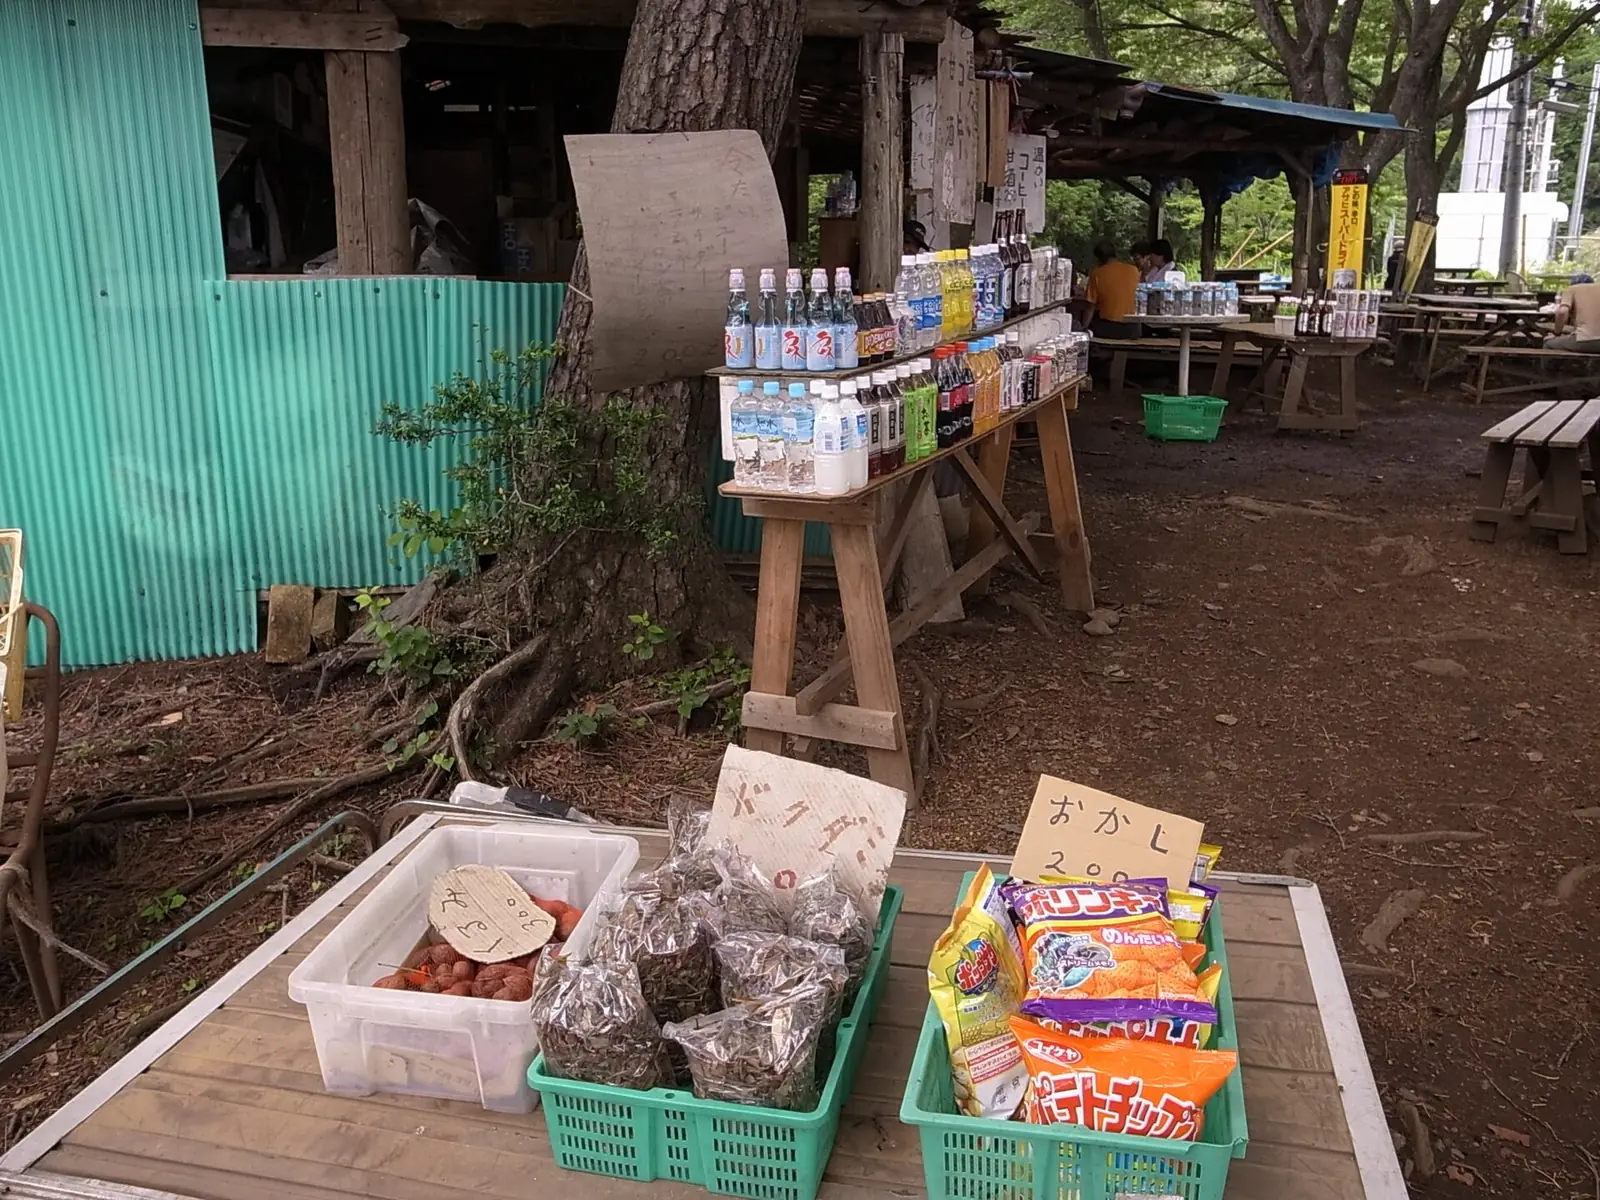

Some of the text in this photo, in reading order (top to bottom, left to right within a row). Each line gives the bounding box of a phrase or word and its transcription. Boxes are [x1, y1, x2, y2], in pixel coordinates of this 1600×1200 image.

[1337, 186, 1351, 268] アサヒスーパードライ
[1049, 794, 1169, 855] おかし
[1044, 850, 1129, 883] 200
[441, 887, 503, 954] くるみ
[506, 897, 549, 932] 300
[1021, 887, 1164, 920] ポリンキー
[1032, 1039, 1079, 1062] コイケヤ
